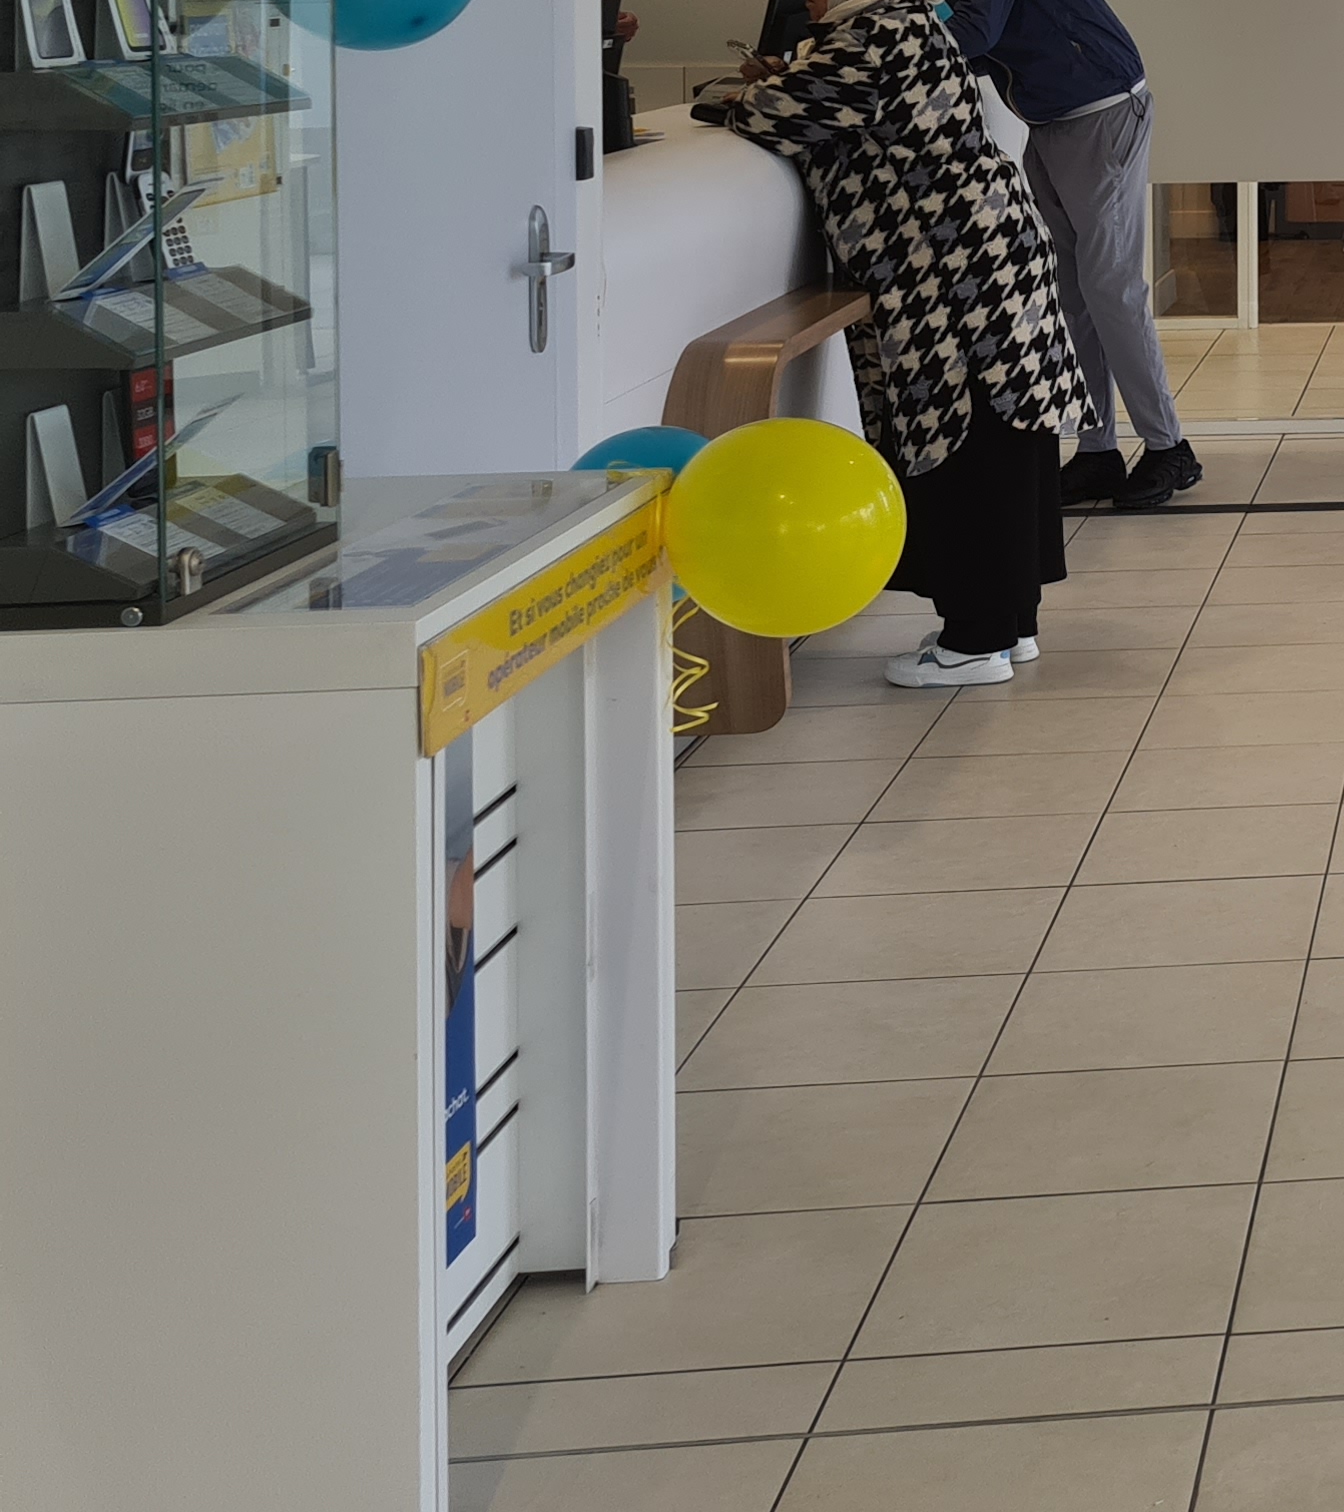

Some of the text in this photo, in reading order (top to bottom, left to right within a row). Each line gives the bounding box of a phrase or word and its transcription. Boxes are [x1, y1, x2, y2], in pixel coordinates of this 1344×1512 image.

[487, 631, 548, 693] opérateur
[548, 605, 585, 647] mobile
[586, 580, 622, 626] proche
[622, 567, 635, 593] de
[635, 555, 657, 582] vous
[510, 609, 523, 637] Et
[525, 597, 536, 626] si
[536, 586, 564, 618] vous
[564, 555, 611, 601] changiez
[611, 539, 635, 574] pour
